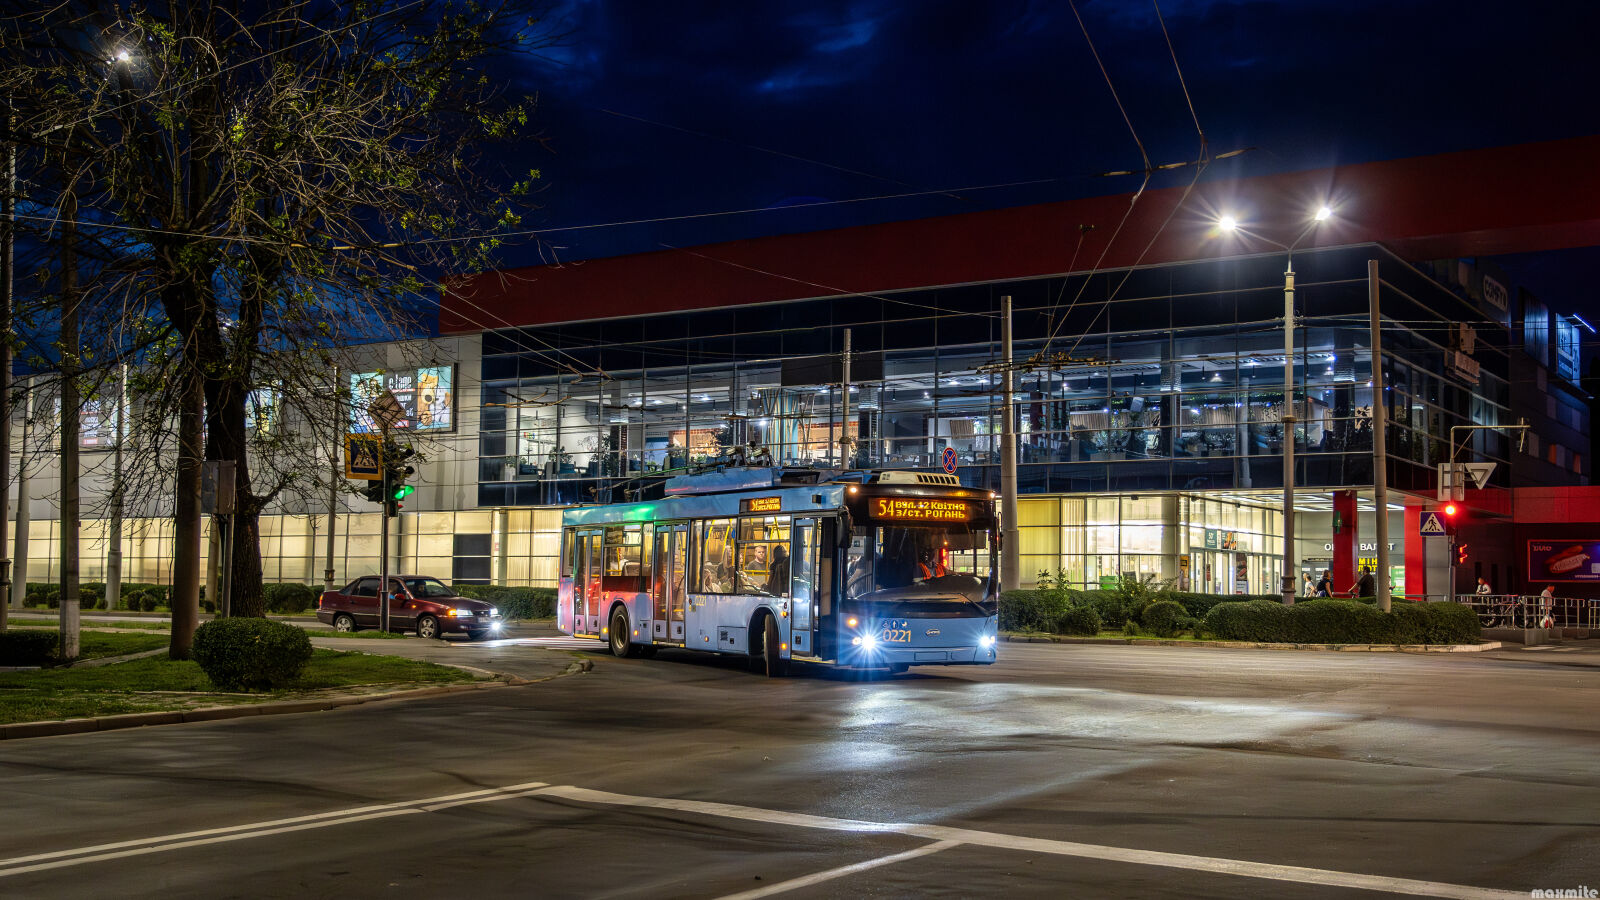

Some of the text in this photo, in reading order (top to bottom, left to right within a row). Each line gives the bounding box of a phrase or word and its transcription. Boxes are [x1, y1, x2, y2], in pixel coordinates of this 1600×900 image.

[879, 500, 894, 516] 54
[918, 502, 930, 510] 12
[925, 510, 966, 518] РОГАНЬ
[1360, 543, 1394, 551] ВАЛТ
[882, 629, 912, 643] 0221
